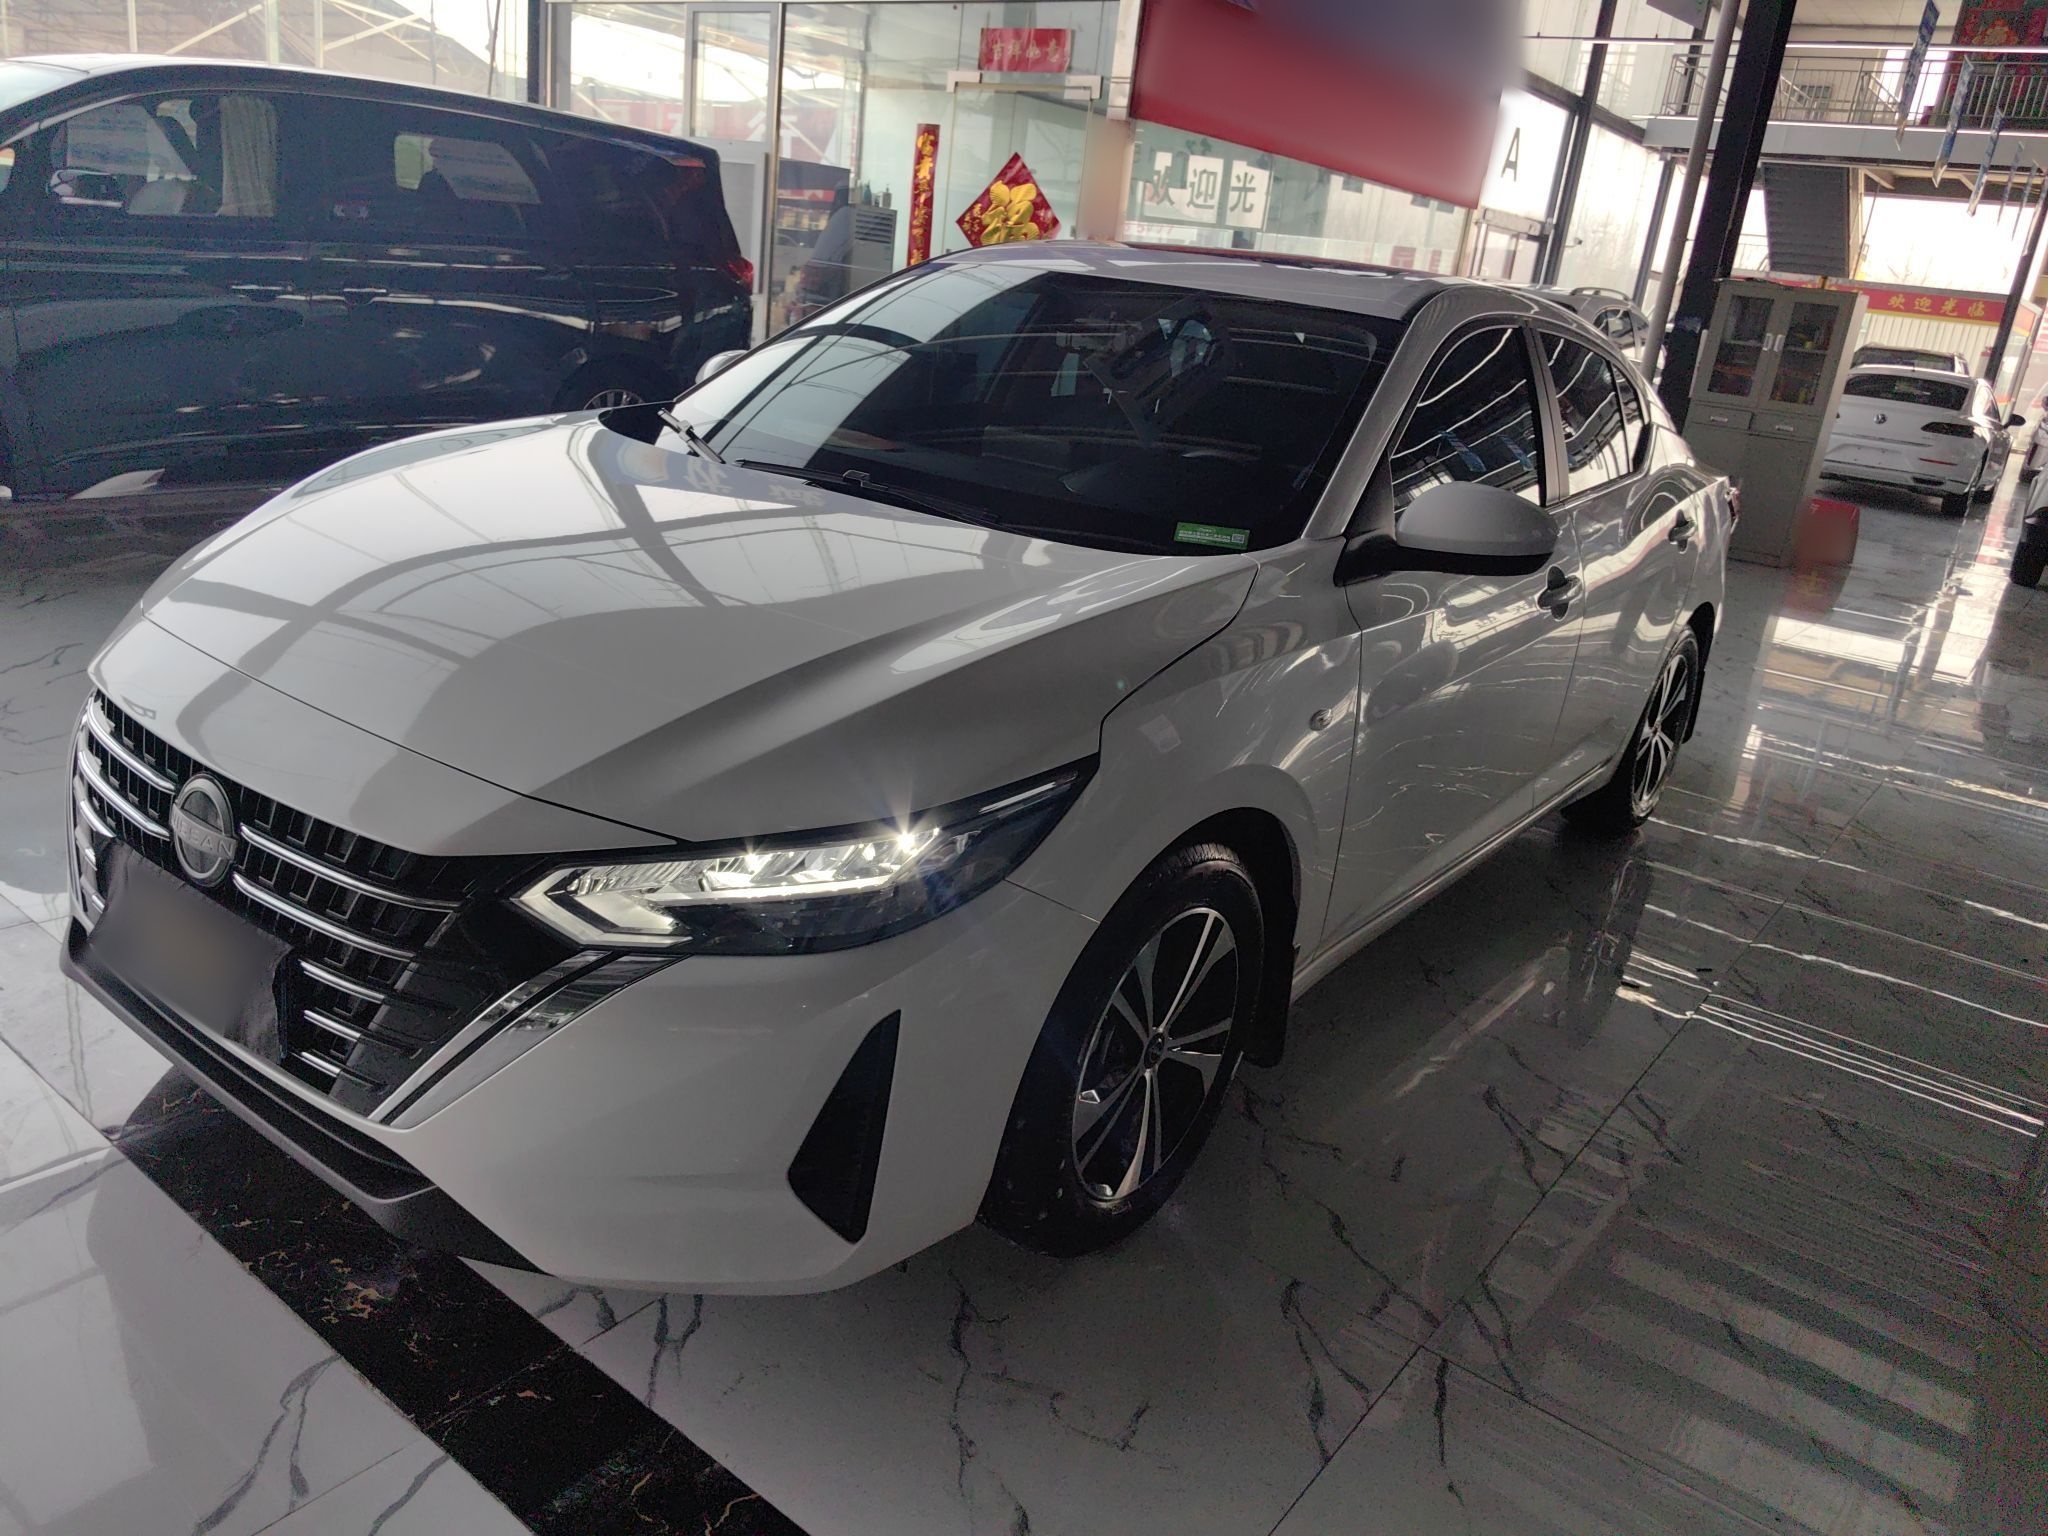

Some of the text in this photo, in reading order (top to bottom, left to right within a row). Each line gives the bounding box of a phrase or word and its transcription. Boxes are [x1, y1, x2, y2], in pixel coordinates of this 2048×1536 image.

[991, 38, 1060, 63] 吉祥如意
[1501, 127, 1521, 182] A
[1888, 294, 1985, 317] 欢迎光临
